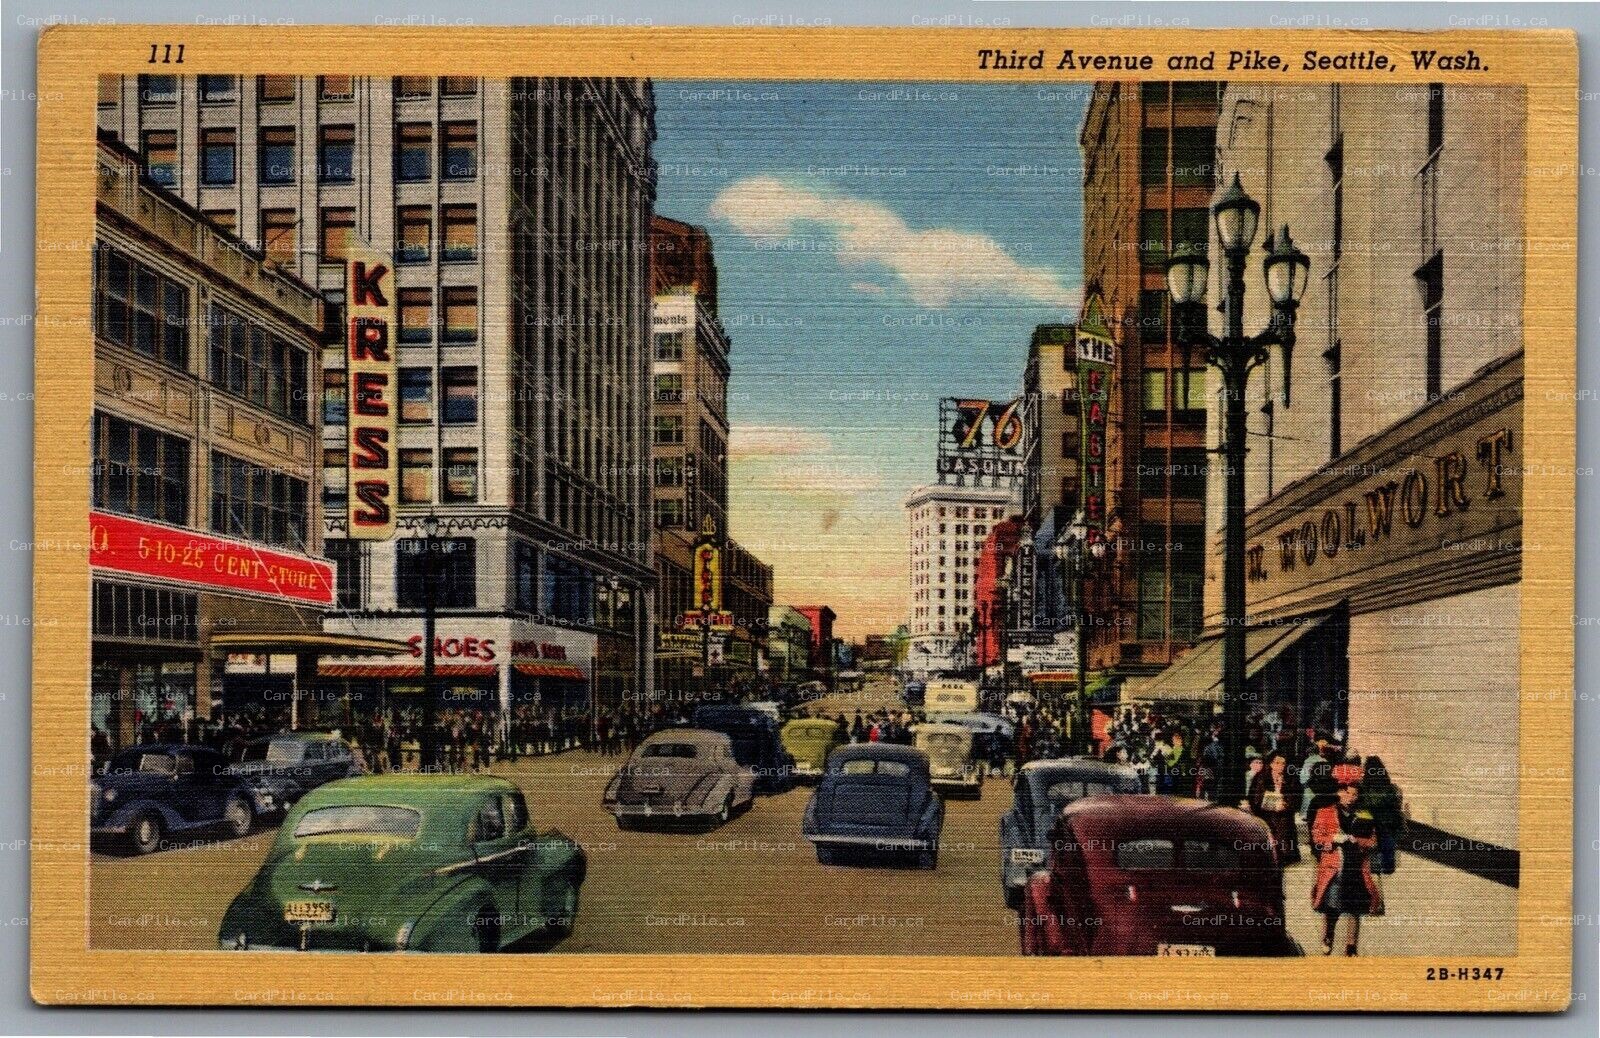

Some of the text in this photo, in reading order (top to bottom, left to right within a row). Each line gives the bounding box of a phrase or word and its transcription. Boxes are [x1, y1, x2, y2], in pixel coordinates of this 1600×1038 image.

[148, 44, 185, 64] 111
[977, 49, 1490, 73] Third Avenue and Pike, Seattle, Wash.
[1079, 338, 1113, 363] THE
[352, 261, 390, 528] KRESS
[957, 397, 1023, 449] 76
[1276, 428, 1513, 573] WOOLWORT
[138, 536, 204, 569] 5-10-25
[214, 554, 260, 580] CENT
[1426, 967, 1504, 981] 2B-H347
